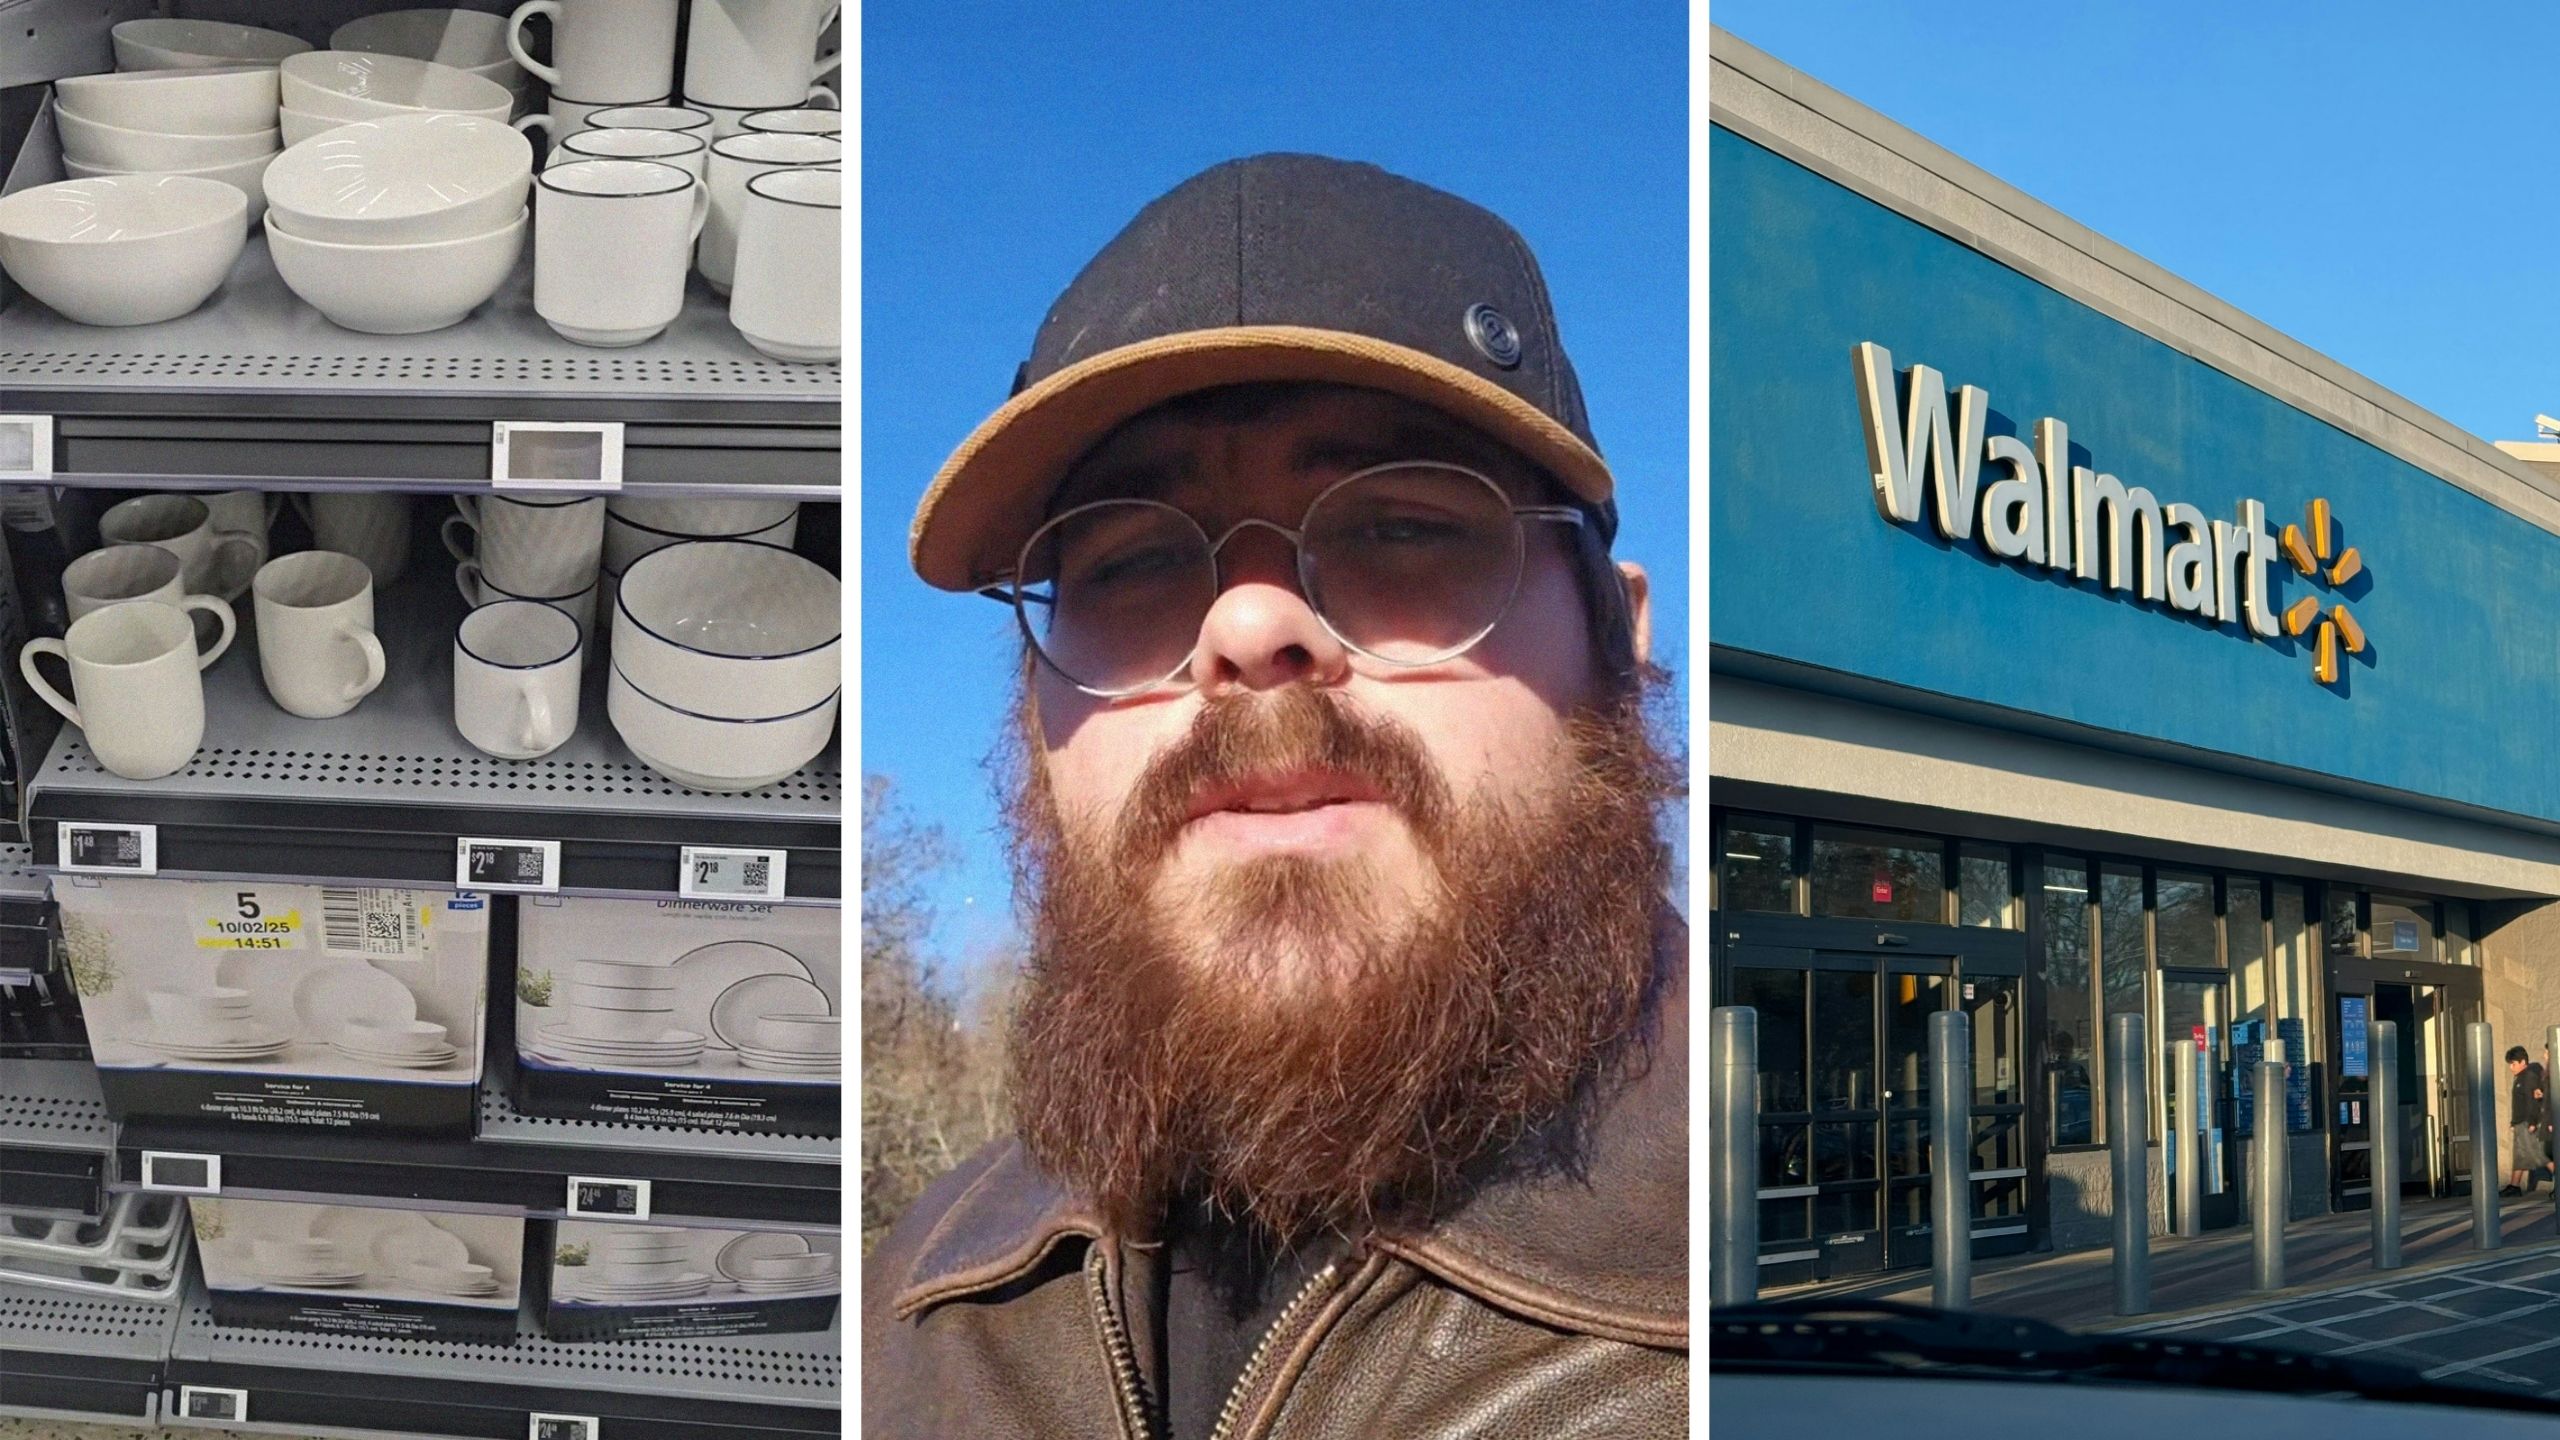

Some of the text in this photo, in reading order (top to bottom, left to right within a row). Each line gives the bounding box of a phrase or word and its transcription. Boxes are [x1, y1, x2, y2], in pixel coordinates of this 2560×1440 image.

[1852, 341, 2279, 638] Walmart
[237, 892, 260, 918] 5
[657, 900, 773, 914] Dinnerware Set
[217, 922, 290, 933] 10/02/25
[234, 938, 280, 949] 14:51
